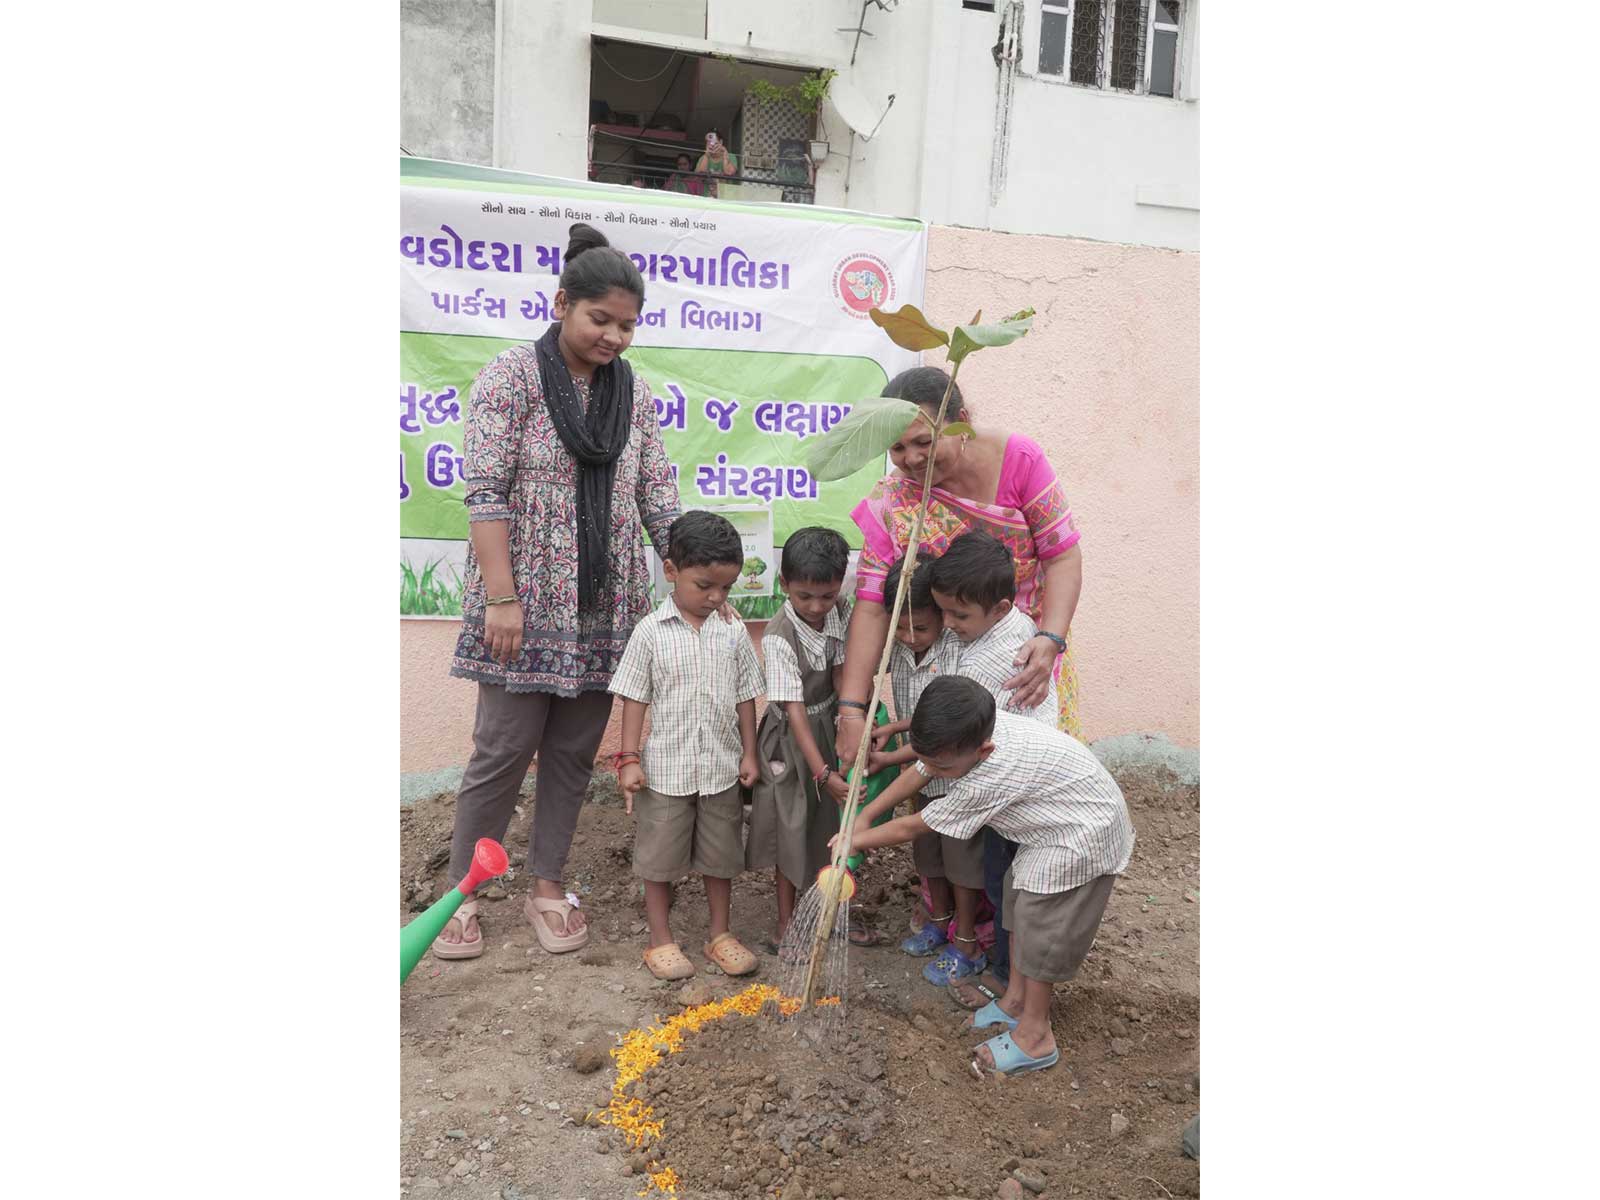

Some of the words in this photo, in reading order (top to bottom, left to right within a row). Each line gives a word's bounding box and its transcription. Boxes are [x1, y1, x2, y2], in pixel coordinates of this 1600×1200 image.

[681, 300, 762, 332] વિભાગ
[705, 400, 739, 431] જ
[697, 454, 817, 502] સંરક્ષણ
